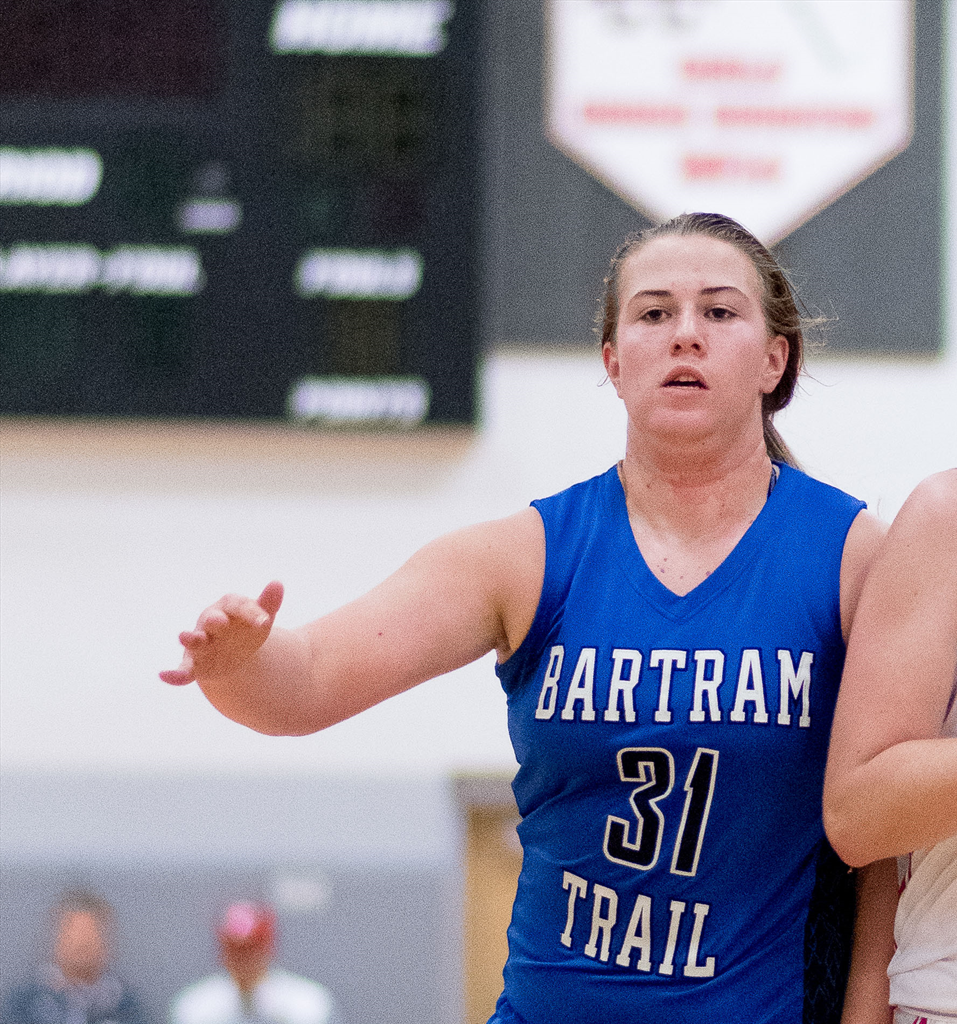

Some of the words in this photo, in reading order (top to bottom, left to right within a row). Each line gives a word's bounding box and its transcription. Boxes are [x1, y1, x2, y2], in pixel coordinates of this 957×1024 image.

[534, 644, 815, 728] BARTRAM
[602, 746, 720, 878] 31
[560, 869, 716, 979] TRAIL
